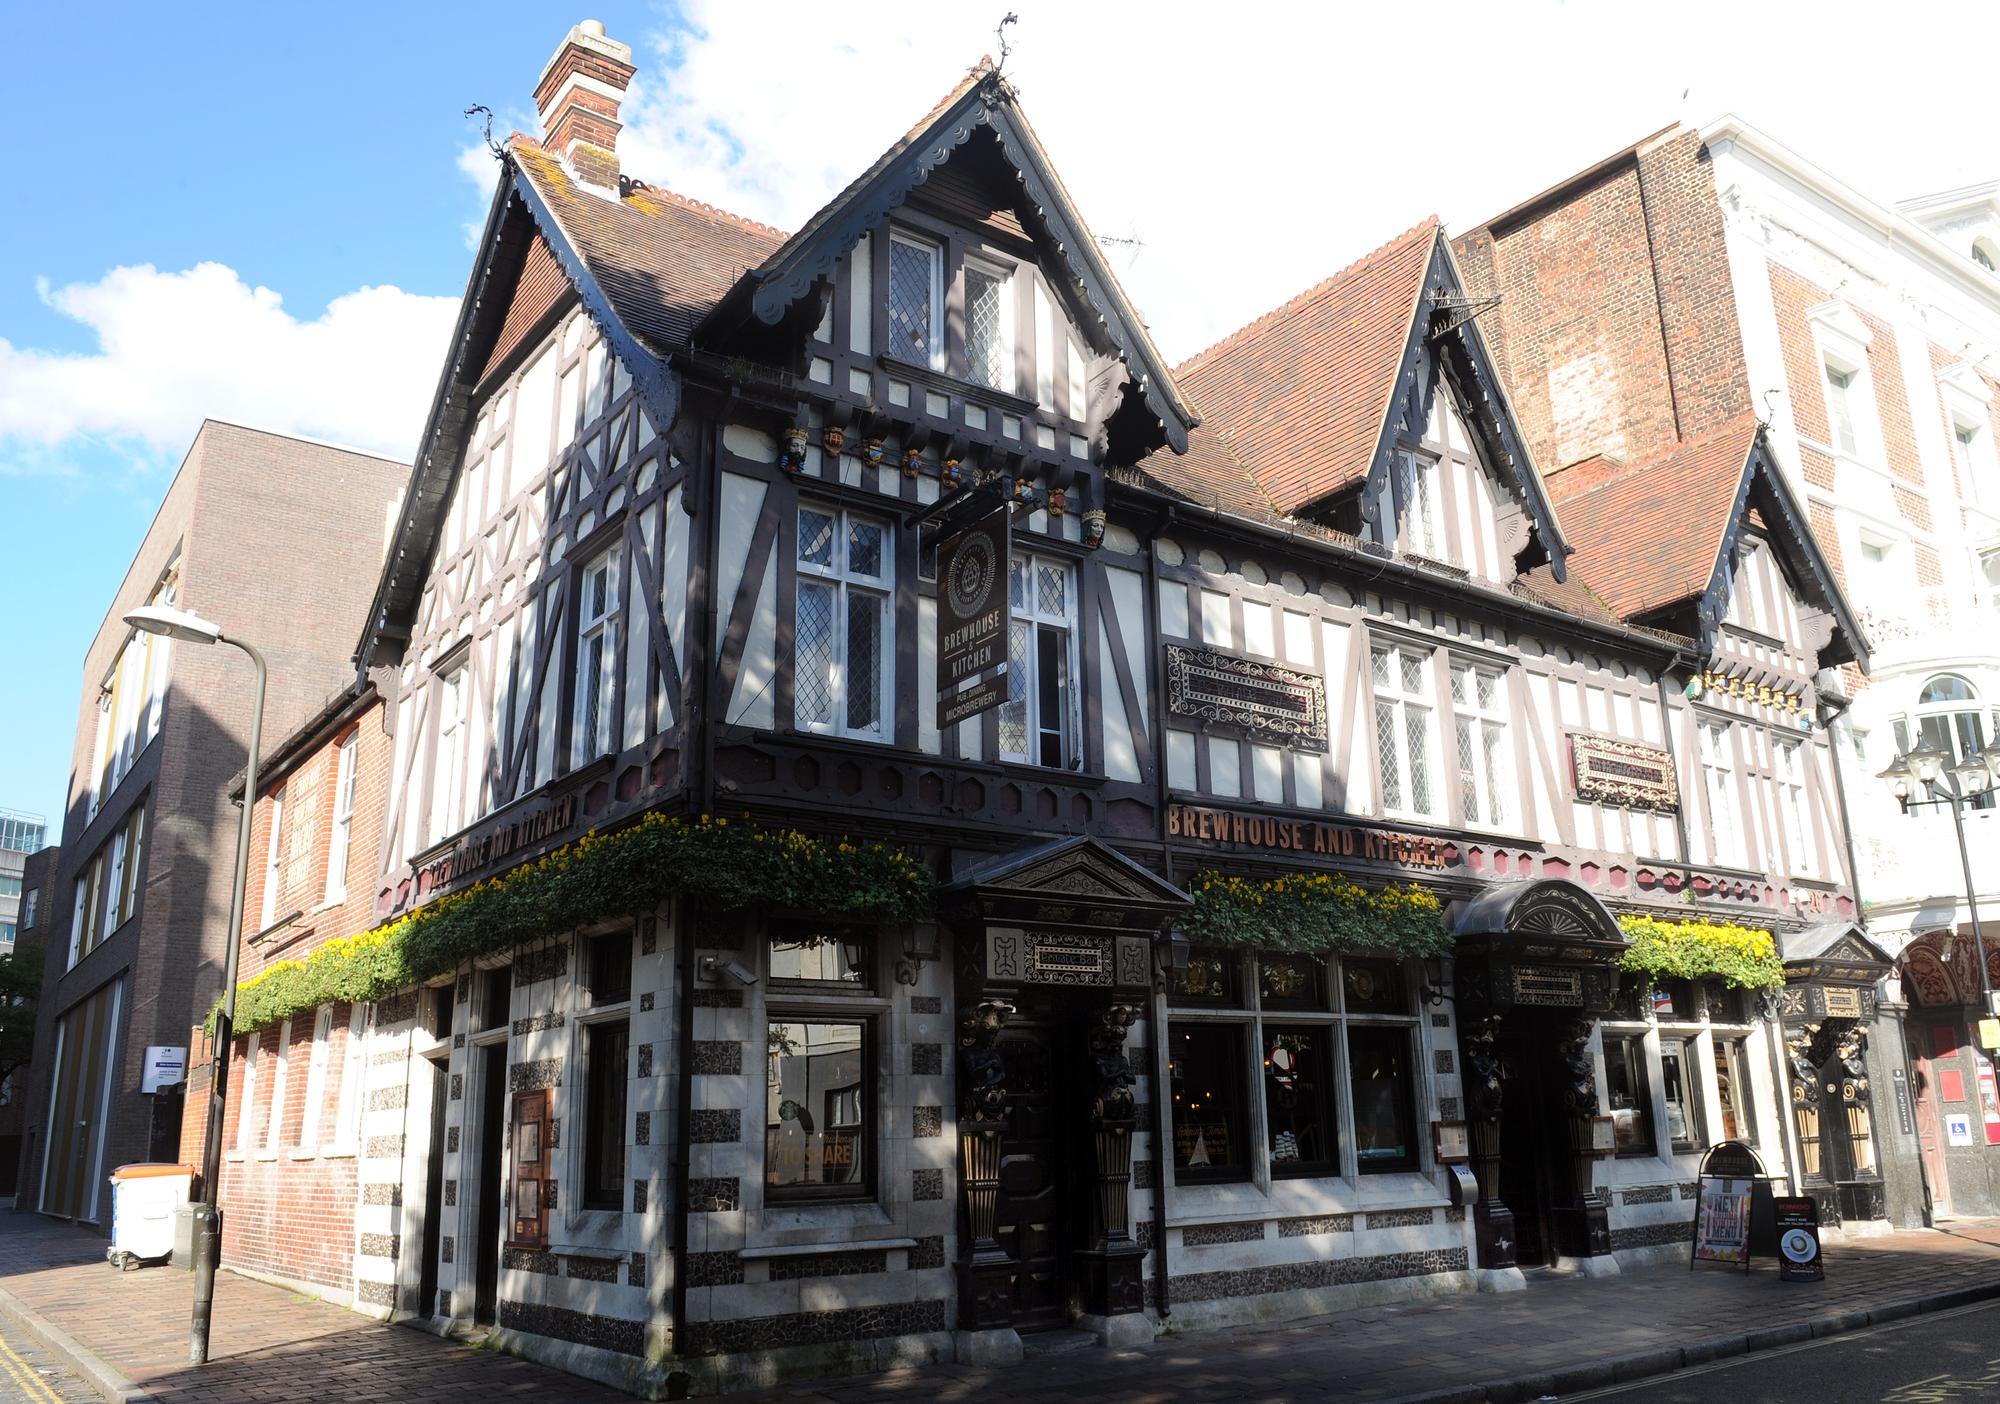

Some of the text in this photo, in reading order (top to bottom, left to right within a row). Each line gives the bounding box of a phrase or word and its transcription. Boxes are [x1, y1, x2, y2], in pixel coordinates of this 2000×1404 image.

[944, 610, 1000, 652] BREWHOUSE
[968, 643, 974, 651] &
[952, 645, 991, 678] KITCHEN
[945, 690, 998, 721] MICROBREWERY
[517, 794, 572, 849] KITCHEN
[1168, 804, 1446, 868] BREWHOUSE AND KITCHEN
[1712, 1226, 1737, 1239] MENU
